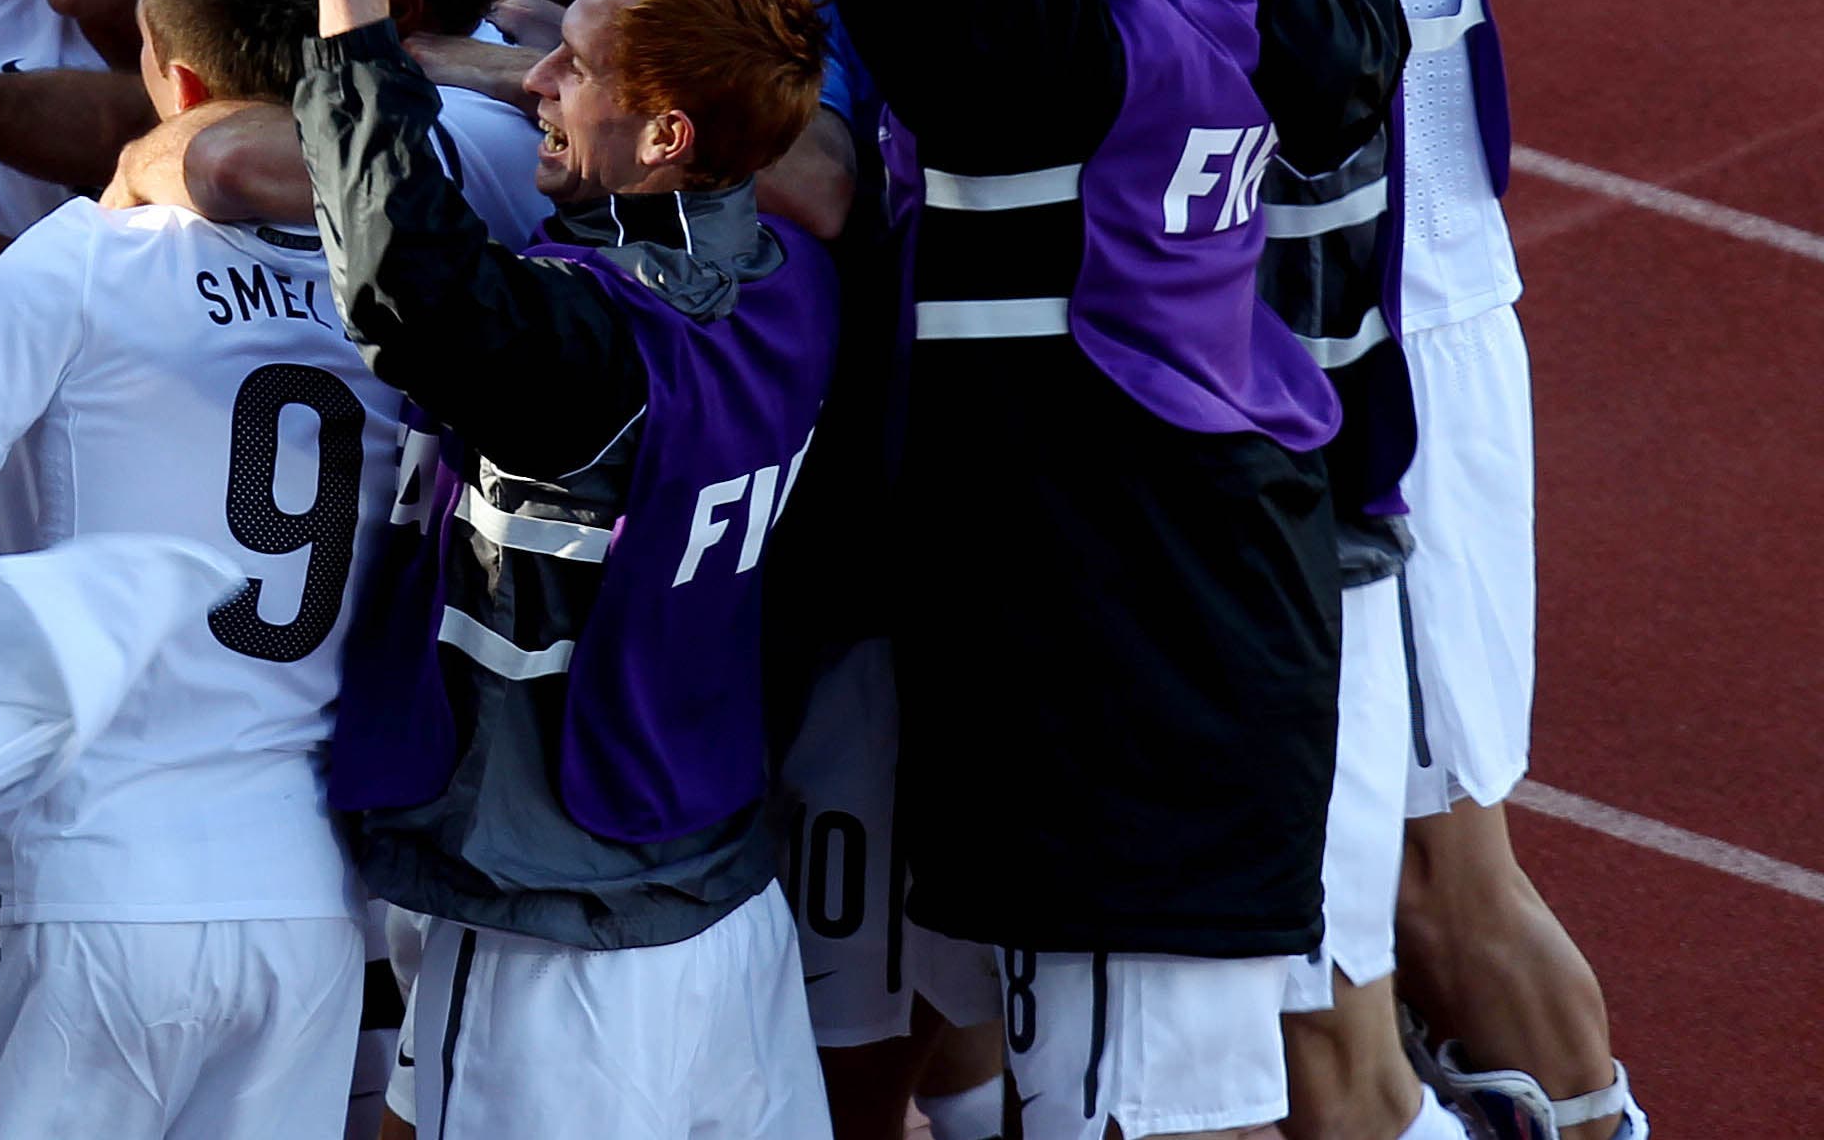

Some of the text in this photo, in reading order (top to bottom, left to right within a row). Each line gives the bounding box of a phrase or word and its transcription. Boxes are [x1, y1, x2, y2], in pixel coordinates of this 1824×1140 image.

[207, 363, 363, 662] 9
[787, 803, 867, 938] 10
[1005, 946, 1037, 1053] 8
